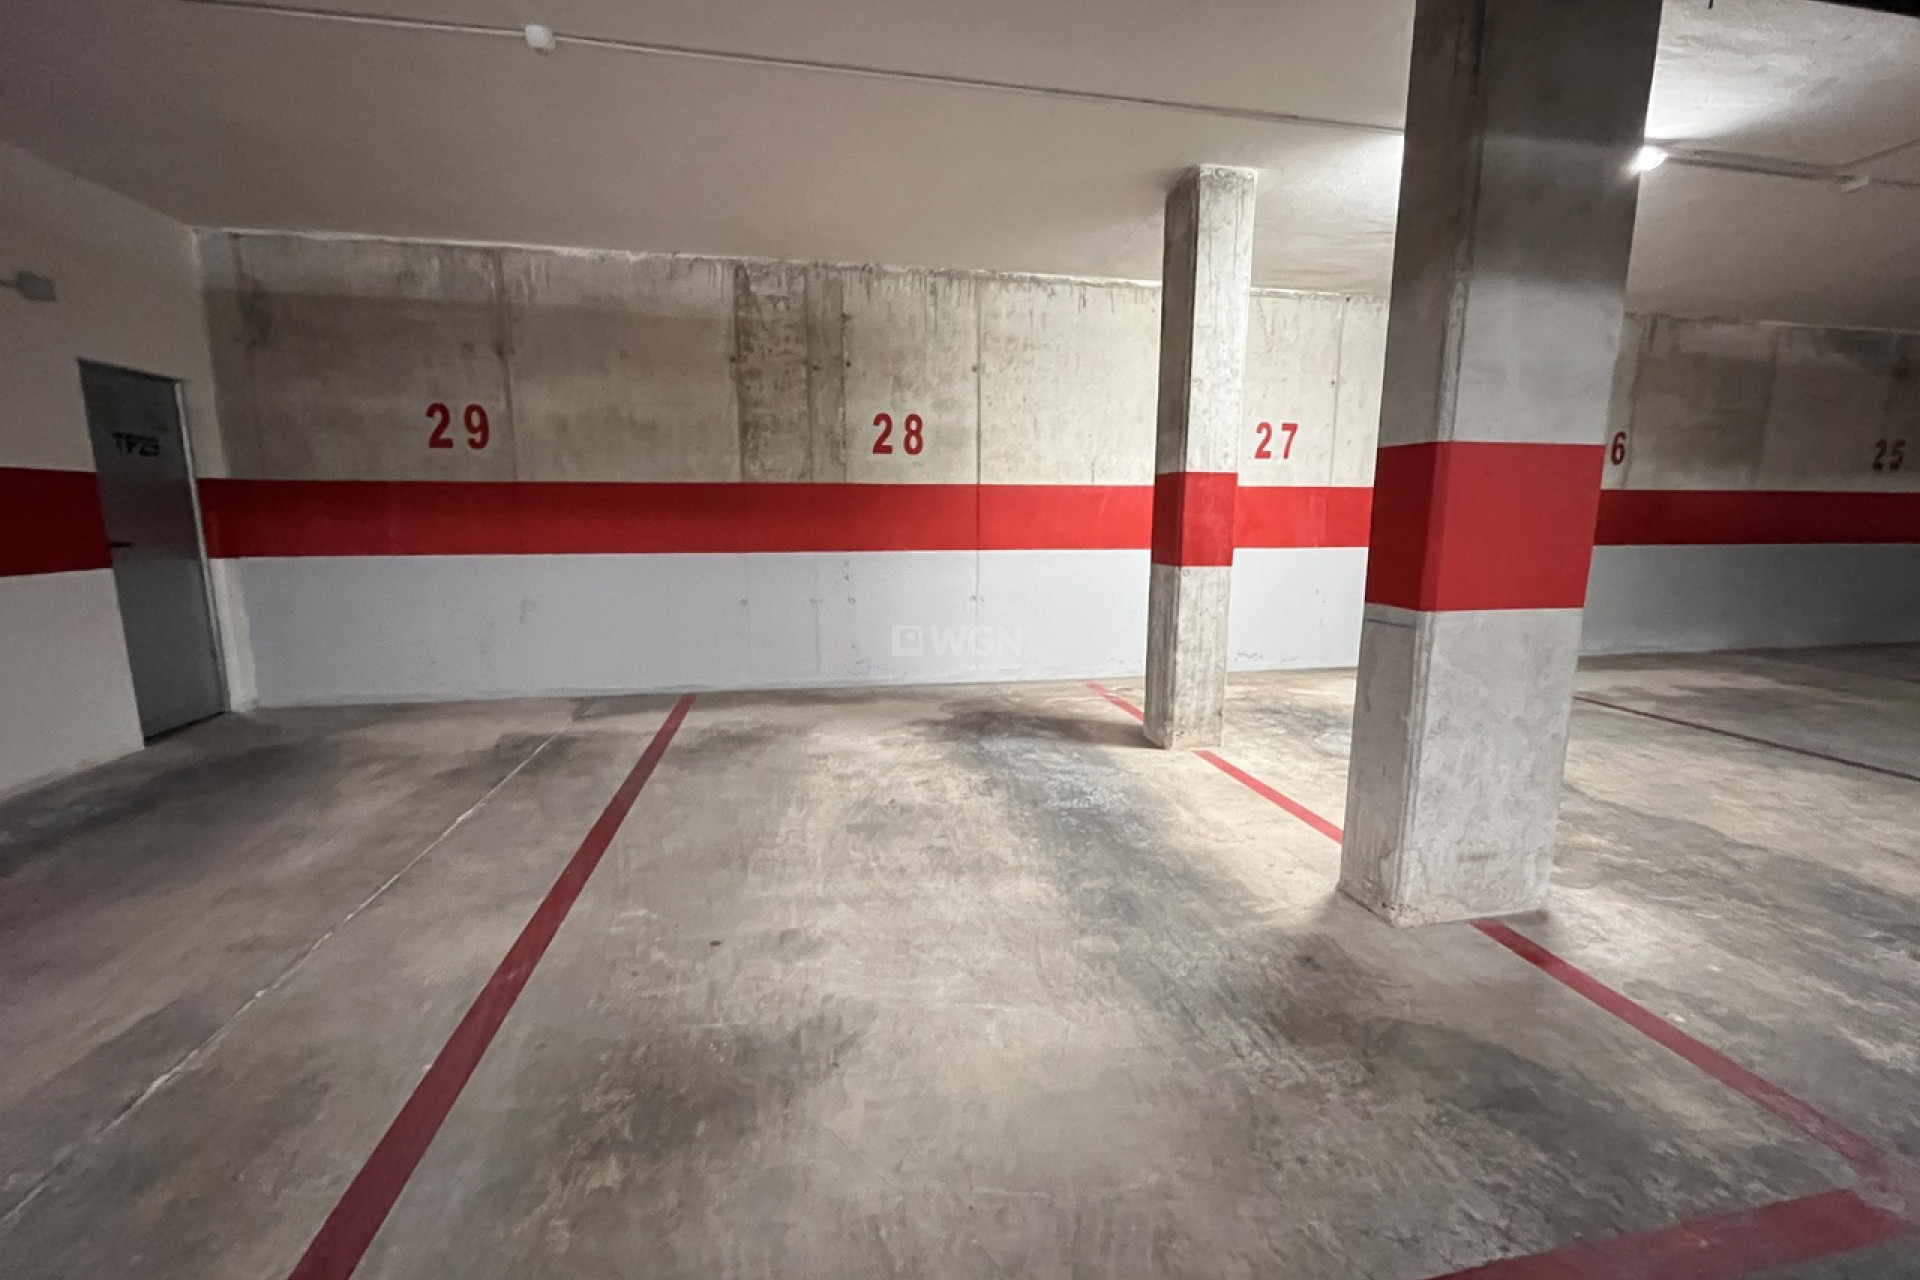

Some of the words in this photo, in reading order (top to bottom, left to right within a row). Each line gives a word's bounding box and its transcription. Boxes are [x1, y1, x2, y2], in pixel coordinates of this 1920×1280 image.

[426, 403, 489, 449] 29
[873, 413, 923, 455] 28
[1254, 421, 1298, 459] 27
[1611, 431, 1627, 466] 6
[1871, 438, 1906, 472] 25
